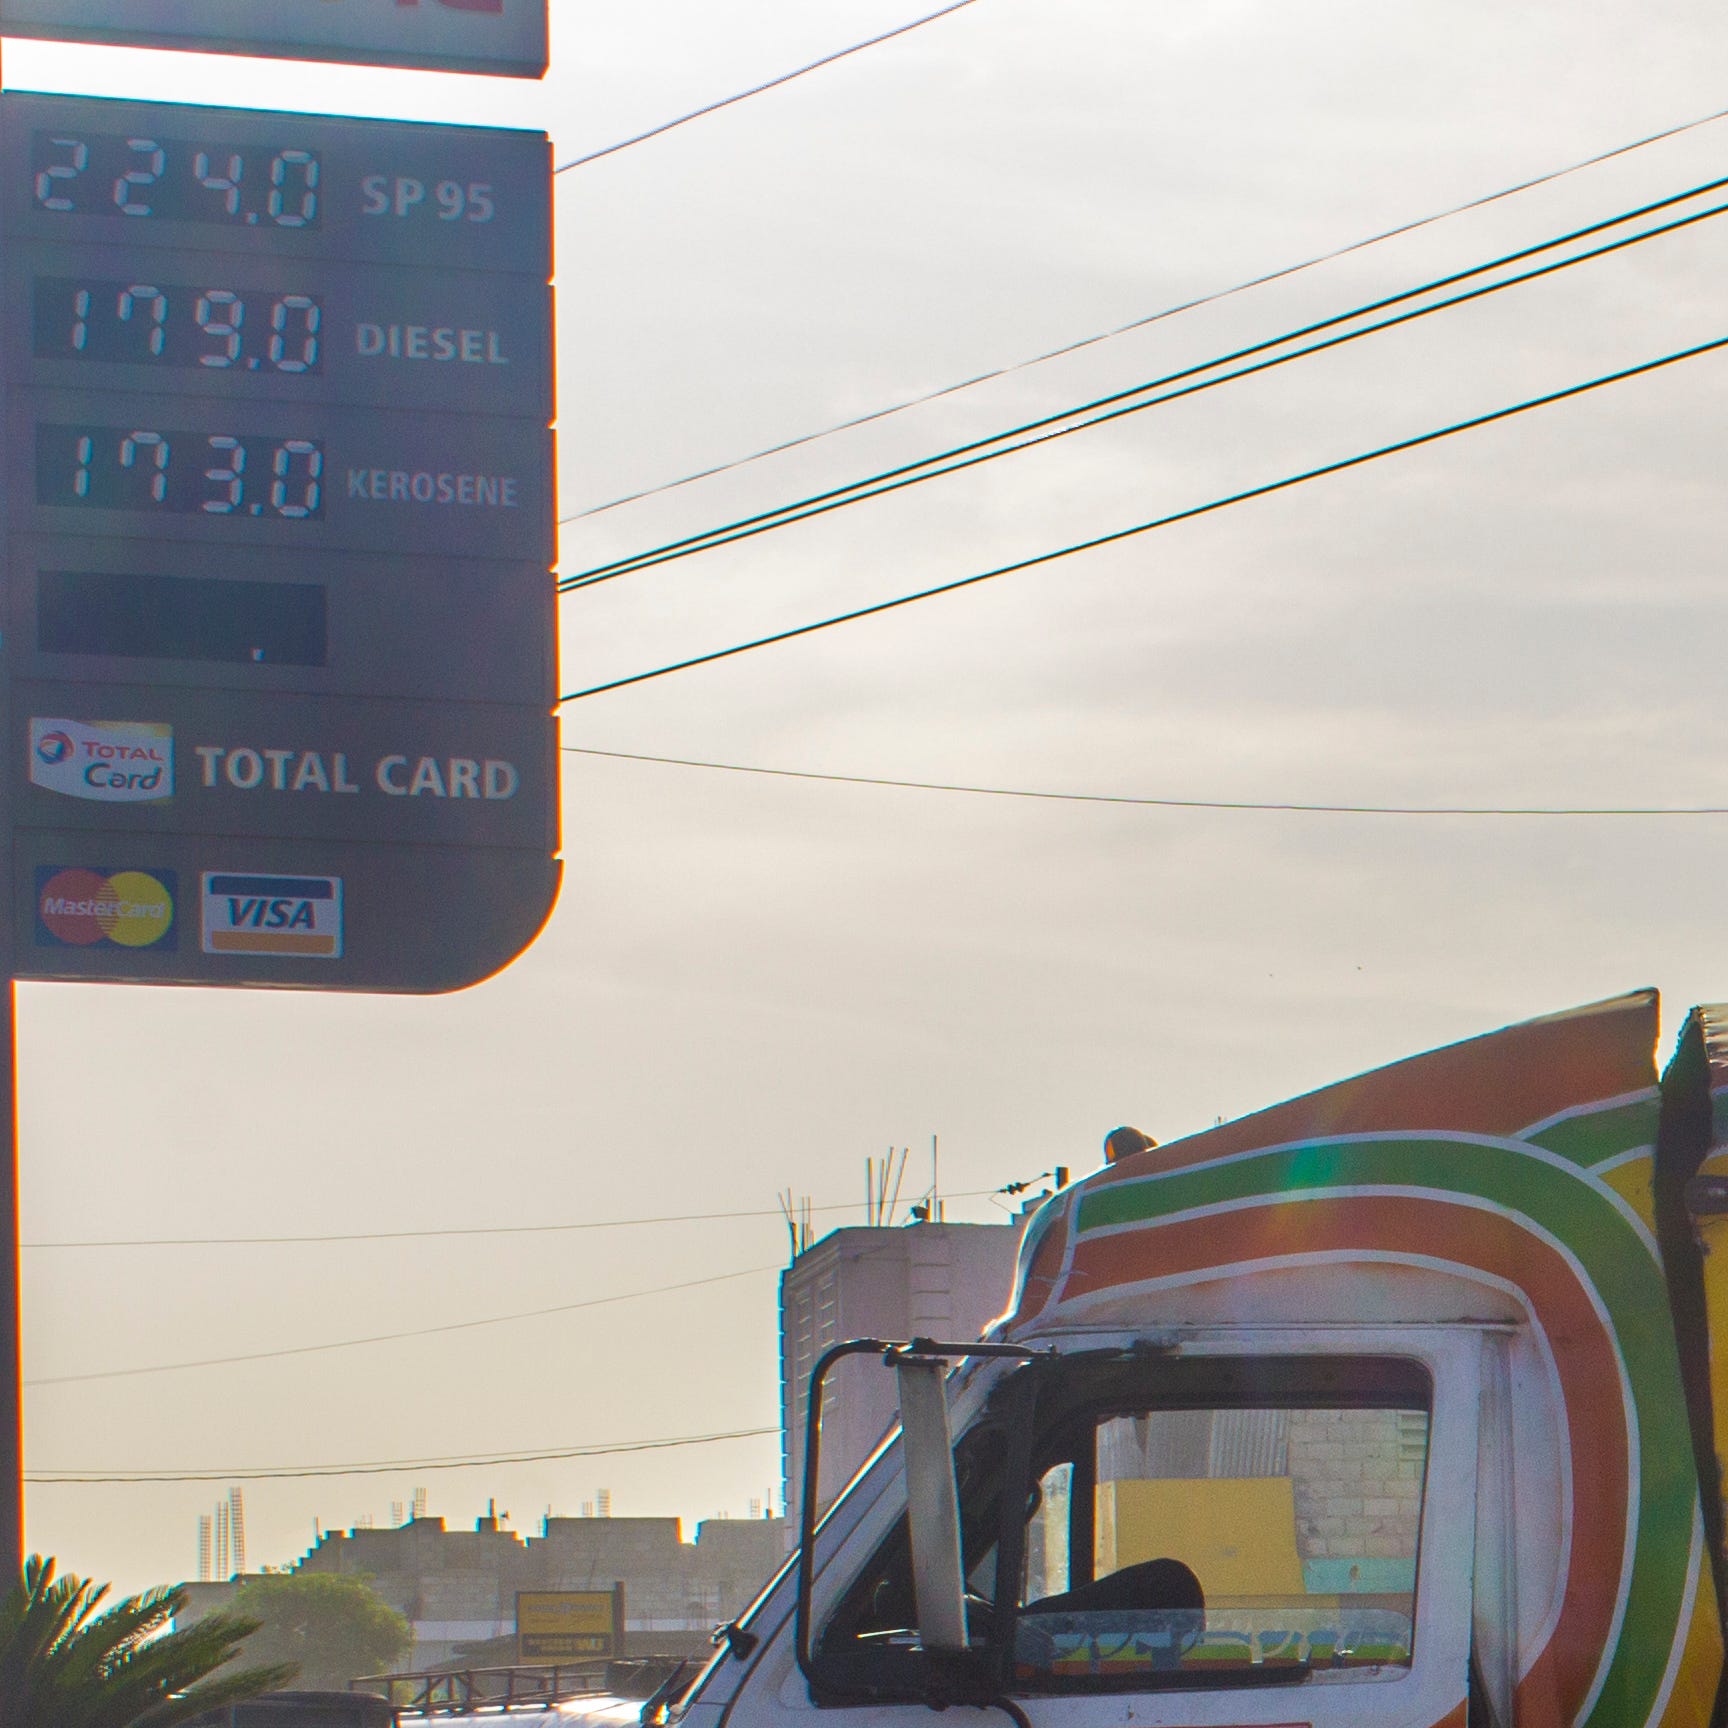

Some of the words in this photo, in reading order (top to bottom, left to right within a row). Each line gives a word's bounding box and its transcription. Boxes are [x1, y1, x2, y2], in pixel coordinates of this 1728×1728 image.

[36, 137, 321, 229] 224.0
[356, 322, 510, 365] DIESEL
[347, 467, 518, 509] KEROSENE
[81, 740, 165, 762] TOTAL
[82, 762, 163, 791] Card
[194, 745, 361, 796] TOTAL
[376, 755, 521, 800] CARD
[44, 896, 167, 919] MasterCard
[226, 896, 318, 930] VISA
